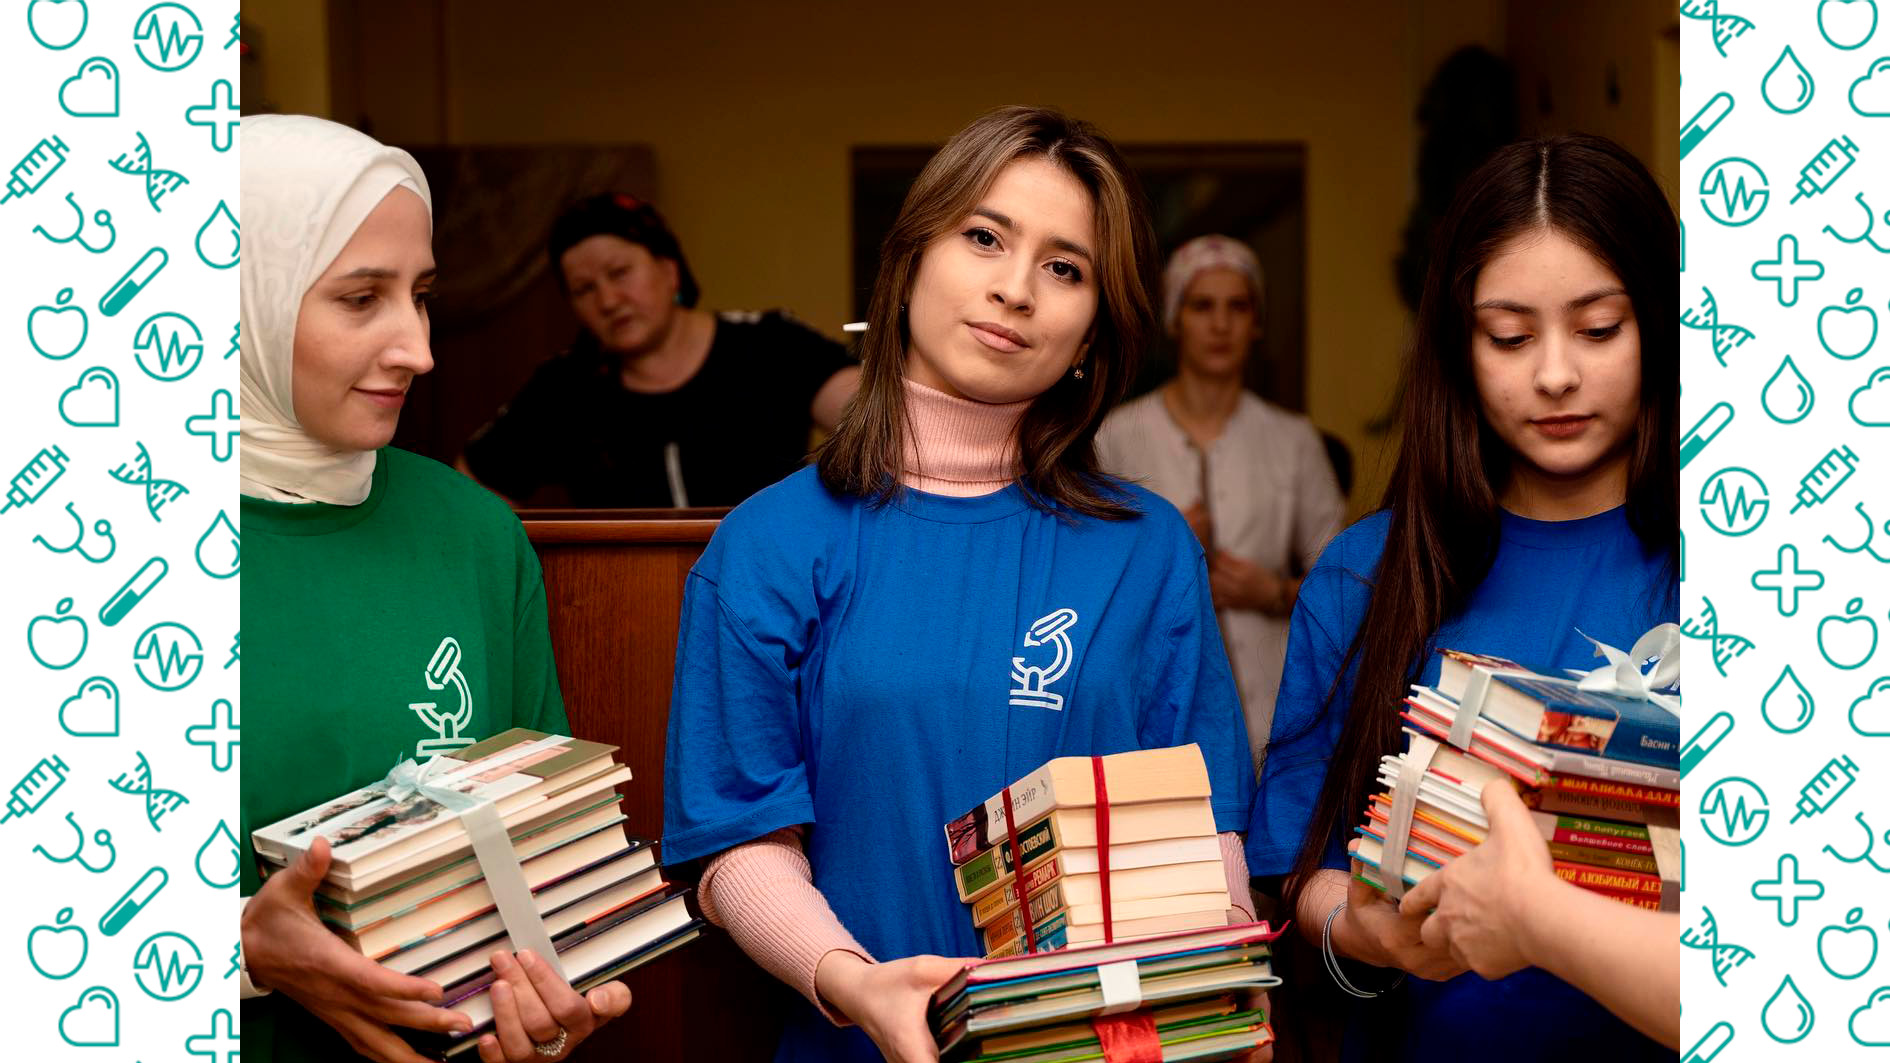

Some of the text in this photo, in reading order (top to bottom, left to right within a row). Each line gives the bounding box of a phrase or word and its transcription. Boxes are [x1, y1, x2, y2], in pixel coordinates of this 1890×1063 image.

[1641, 735, 1670, 751] Басни
[1020, 786, 1037, 807] ЭЙР
[1578, 870, 1640, 890] ЛЮБИМЫЙ
